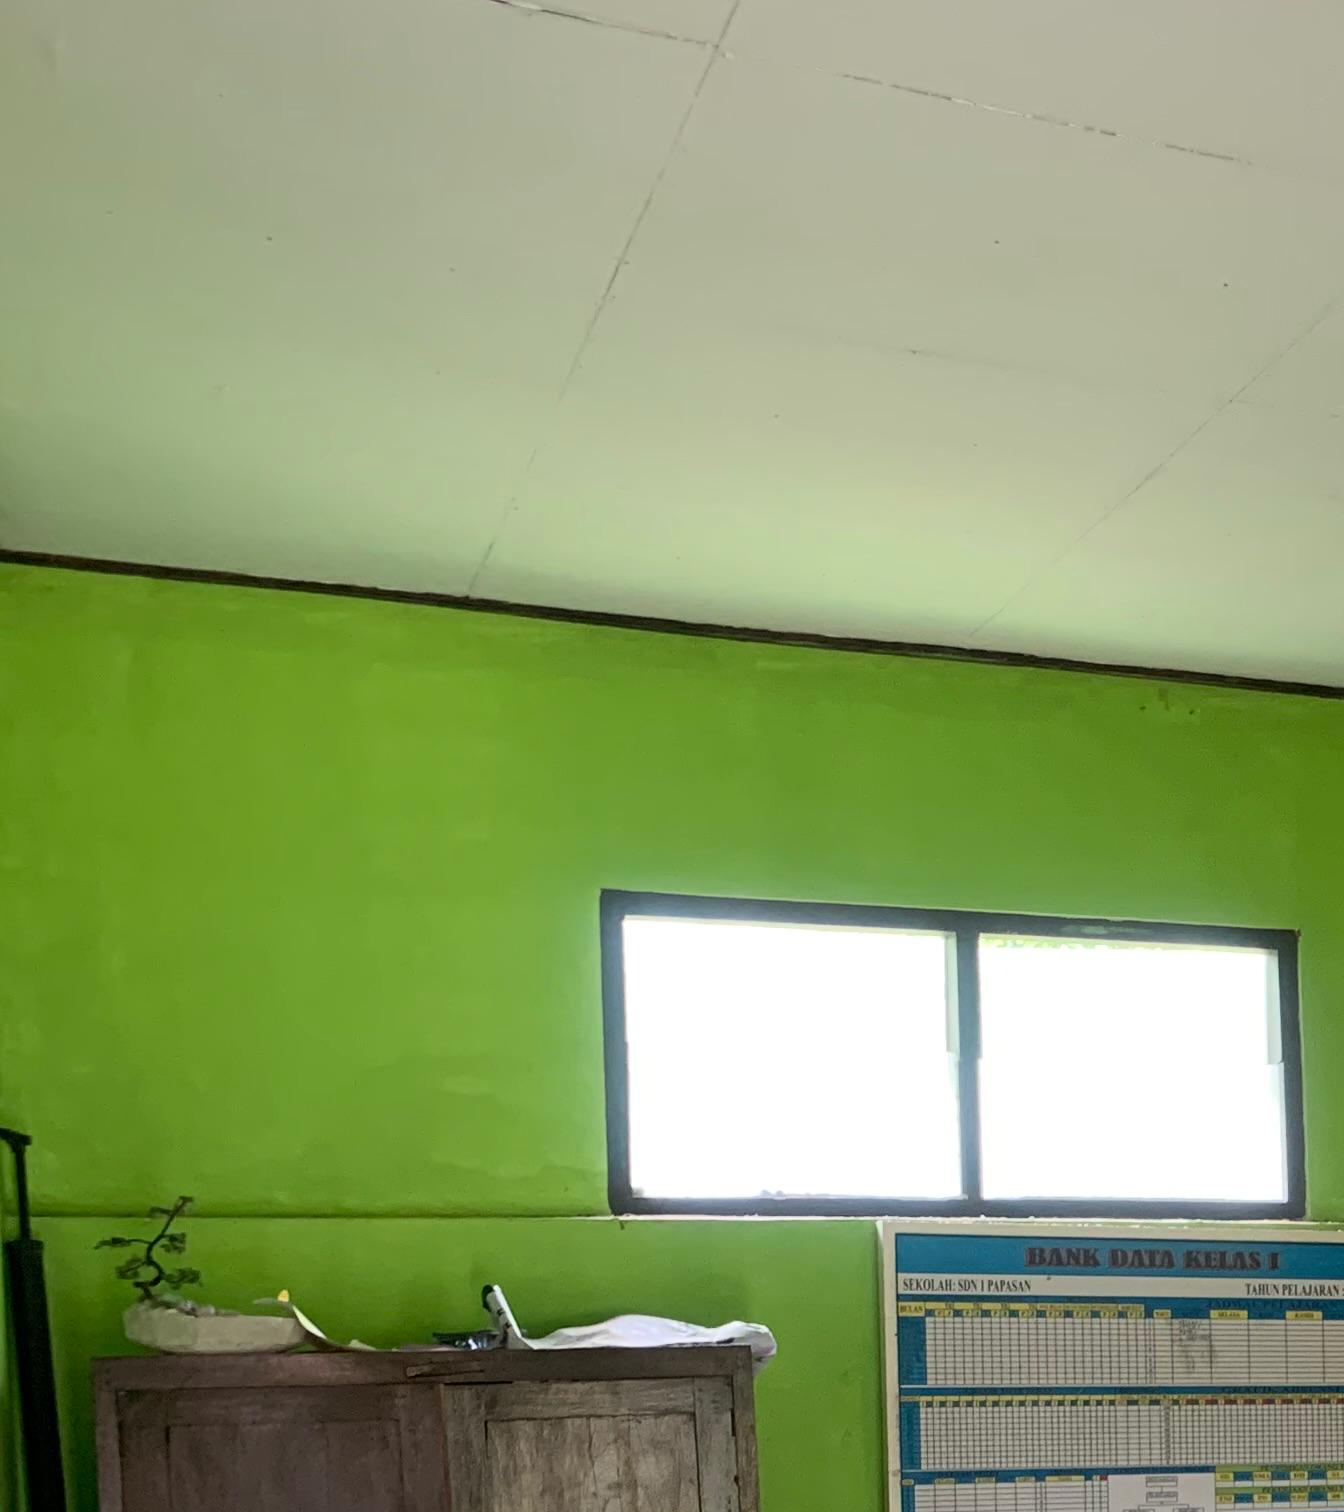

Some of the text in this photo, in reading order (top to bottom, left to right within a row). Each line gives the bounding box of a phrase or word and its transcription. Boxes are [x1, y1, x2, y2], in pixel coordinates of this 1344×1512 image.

[1024, 1247, 1101, 1268] BANK
[1108, 1249, 1176, 1270] DATA
[1183, 1250, 1262, 1271] KELAS
[958, 1279, 978, 1292] SDN
[987, 1279, 1031, 1293] PAPASAN
[1246, 1283, 1280, 1296] TAHUN
[1281, 1284, 1340, 1297] PELAJARAN
